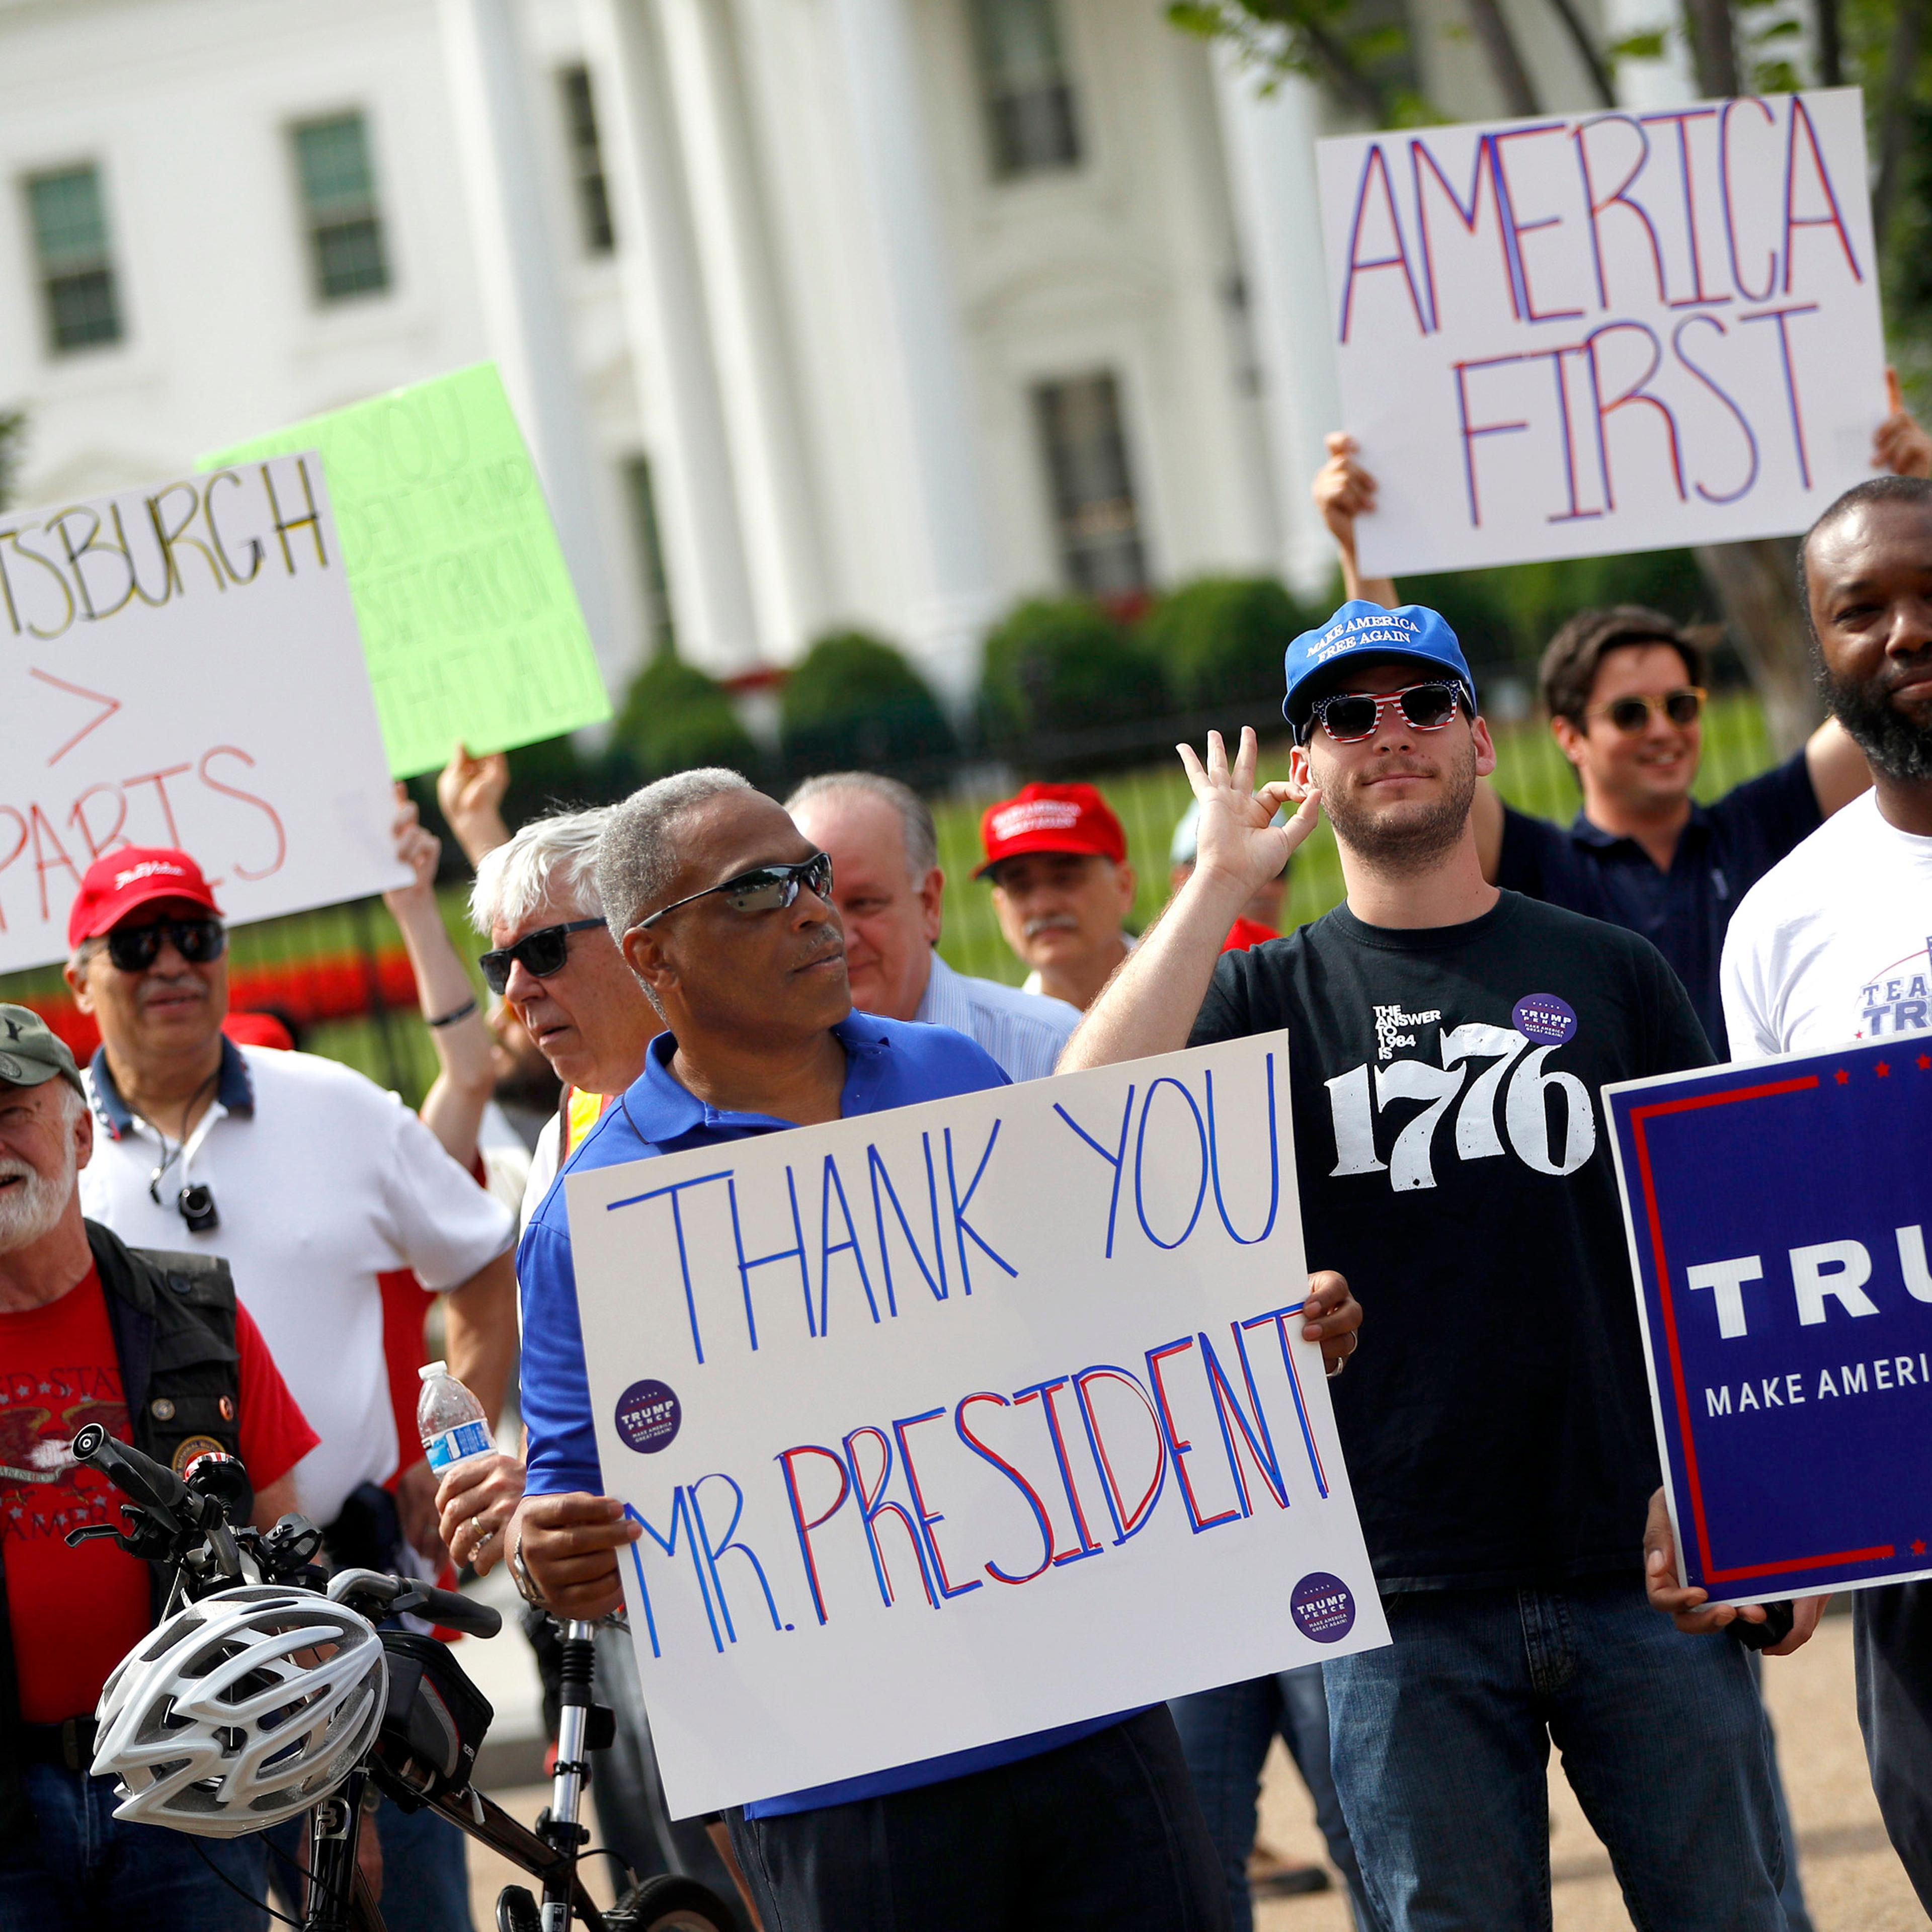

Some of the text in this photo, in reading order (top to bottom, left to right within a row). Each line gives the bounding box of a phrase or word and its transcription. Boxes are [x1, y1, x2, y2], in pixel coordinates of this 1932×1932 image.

[1339, 92, 1865, 345] AMERICA
[1453, 302, 1820, 529] FIRST
[1306, 616, 1421, 658] MAKE AMERICA
[1317, 630, 1411, 664] FREE AGAIN
[1373, 1005, 1401, 1017] THE
[1375, 1010, 1441, 1029] ANSWER
[1519, 1009, 1572, 1023] TRUMP
[1523, 1017, 1566, 1028] PENCE
[1541, 1026, 1564, 1034] AMERICA
[1378, 1025, 1397, 1040] TO
[1380, 1034, 1416, 1048] 1984
[1378, 1047, 1393, 1060] IS
[1323, 1023, 1596, 1192] 1776
[606, 1053, 1279, 1365] THANK YOU
[1705, 1353, 1930, 1417] MAKE AMERI
[621, 1400, 674, 1424] TRUMP
[628, 1411, 671, 1430] PENCE
[623, 1301, 1329, 1658] MR. PRESIDENT
[1297, 1593, 1347, 1615] TRUMP
[1304, 1603, 1345, 1620] PENCE
[1309, 1614, 1347, 1628] MAKE AMERICA
[1312, 1624, 1329, 1632] GREAT
